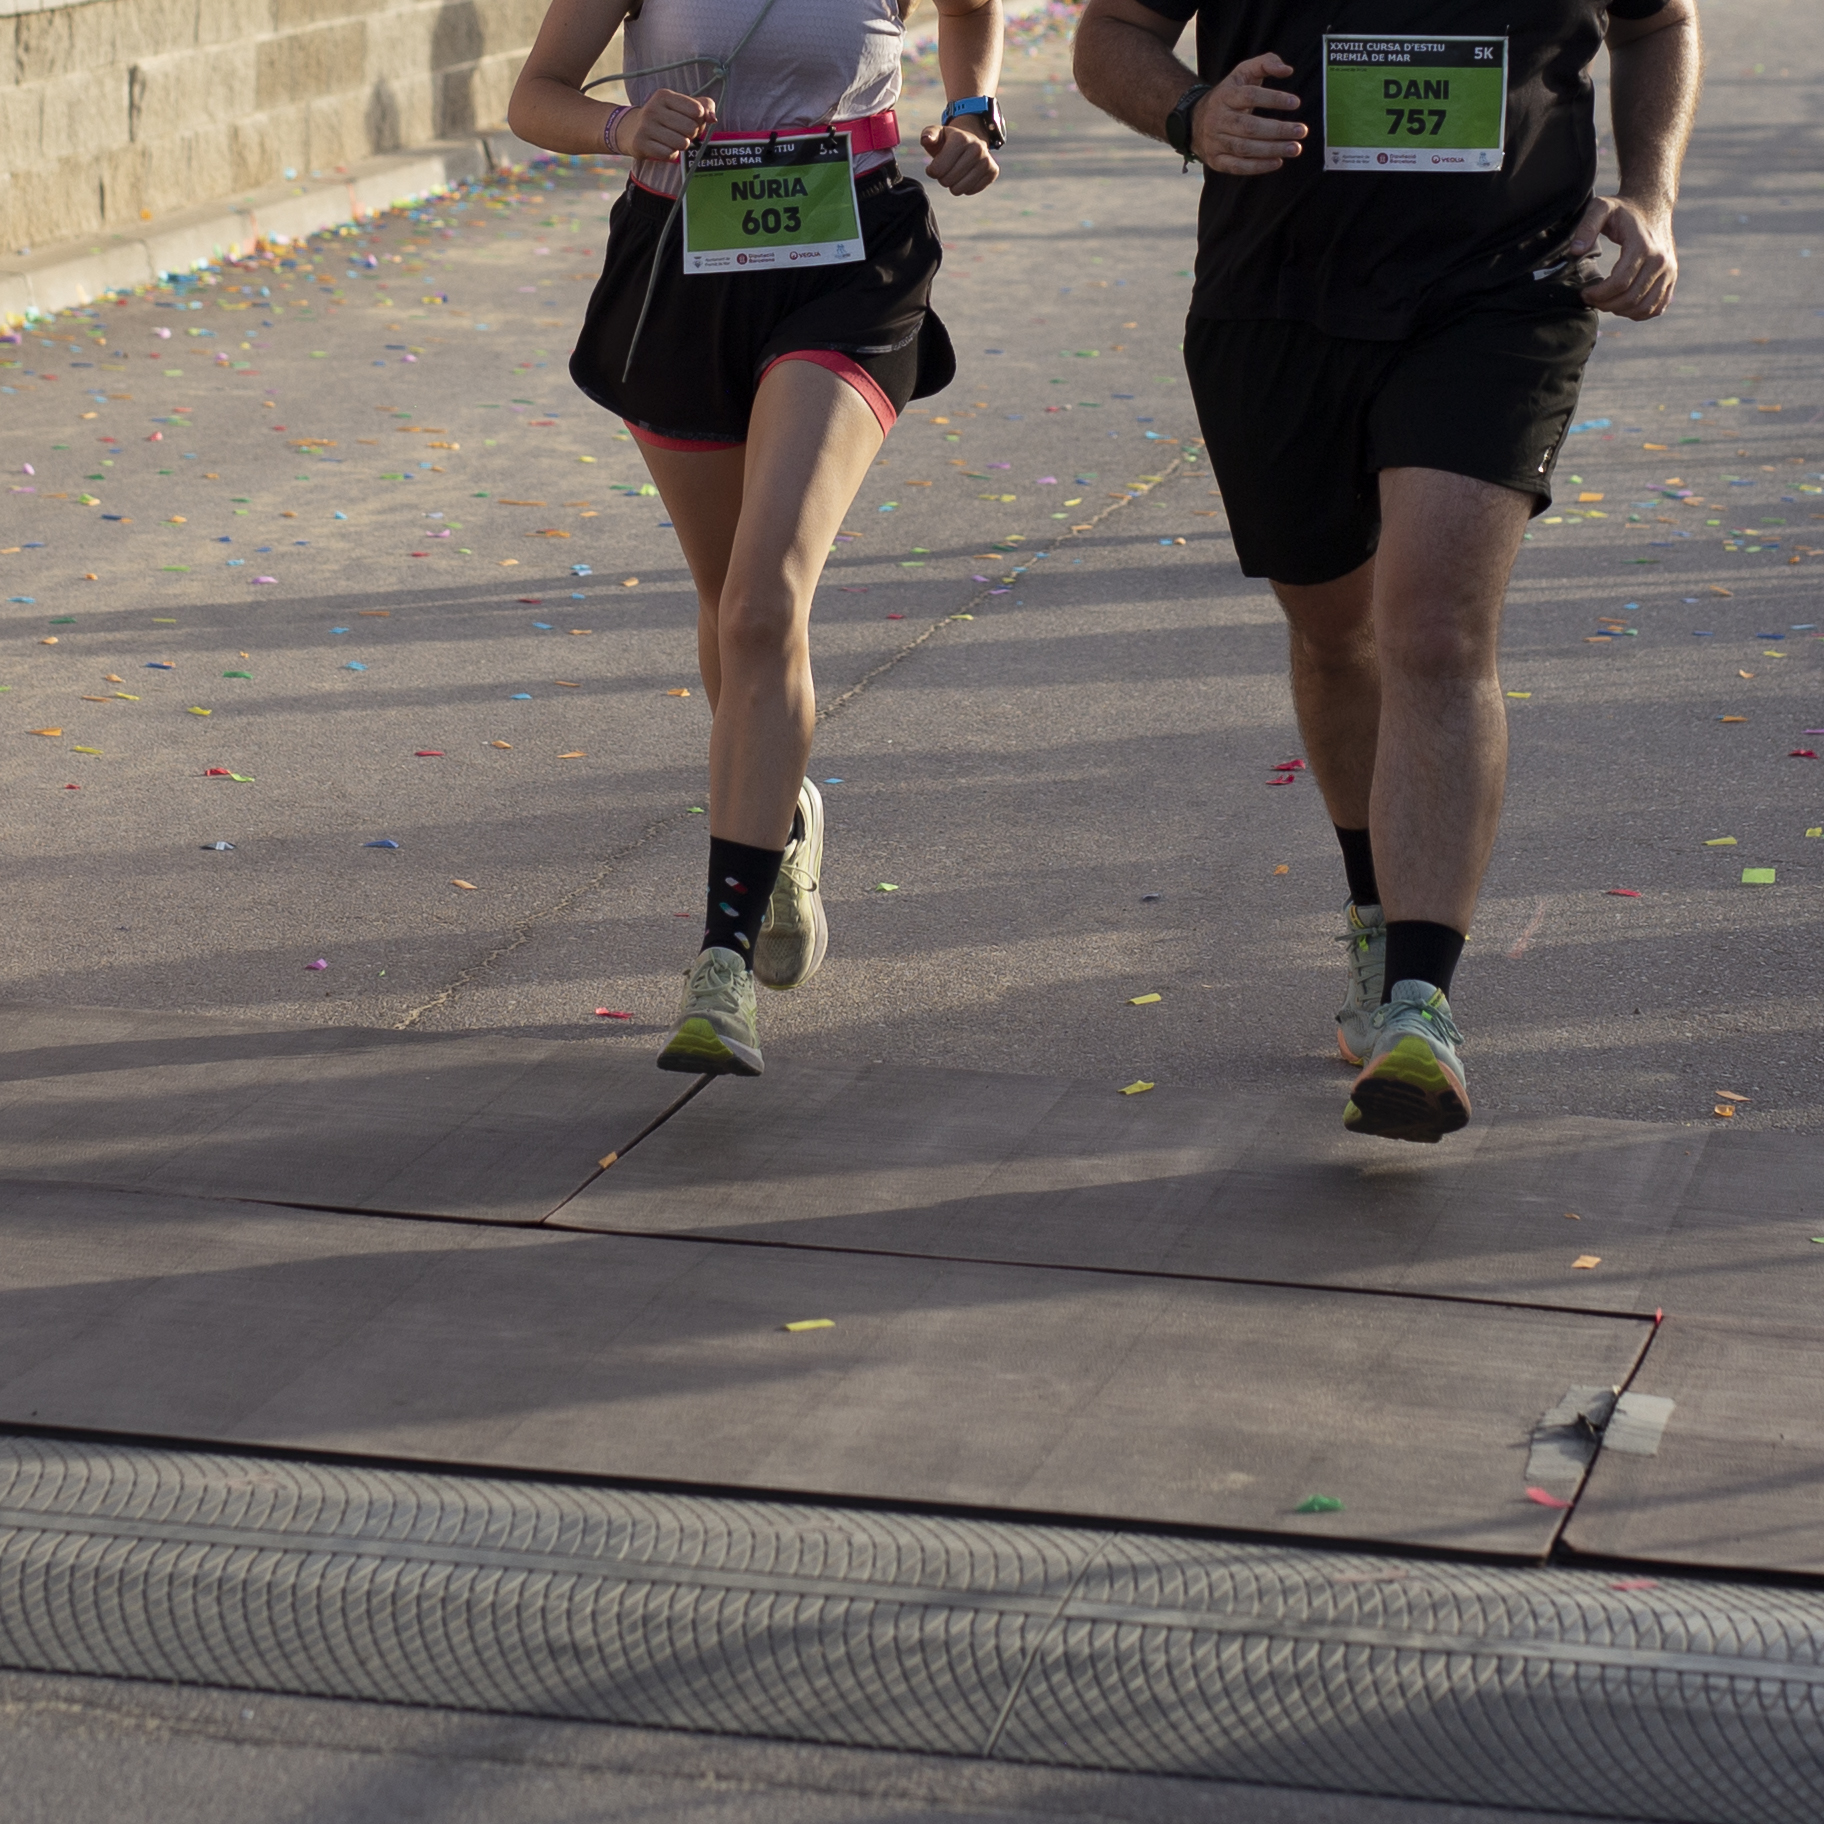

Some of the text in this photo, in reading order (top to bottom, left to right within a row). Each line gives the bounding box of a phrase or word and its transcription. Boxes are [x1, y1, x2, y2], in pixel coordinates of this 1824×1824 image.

[1366, 42, 1401, 51] CURSA
[1473, 46, 1494, 60] 5K
[1330, 51, 1411, 62] PREMIÀ DE MAR
[1383, 79, 1450, 100] DANI
[1385, 108, 1447, 135] 757
[719, 147, 752, 156] CURSA
[726, 158, 738, 166] DE
[731, 174, 808, 202] NÚRIA
[742, 206, 802, 235] 603
